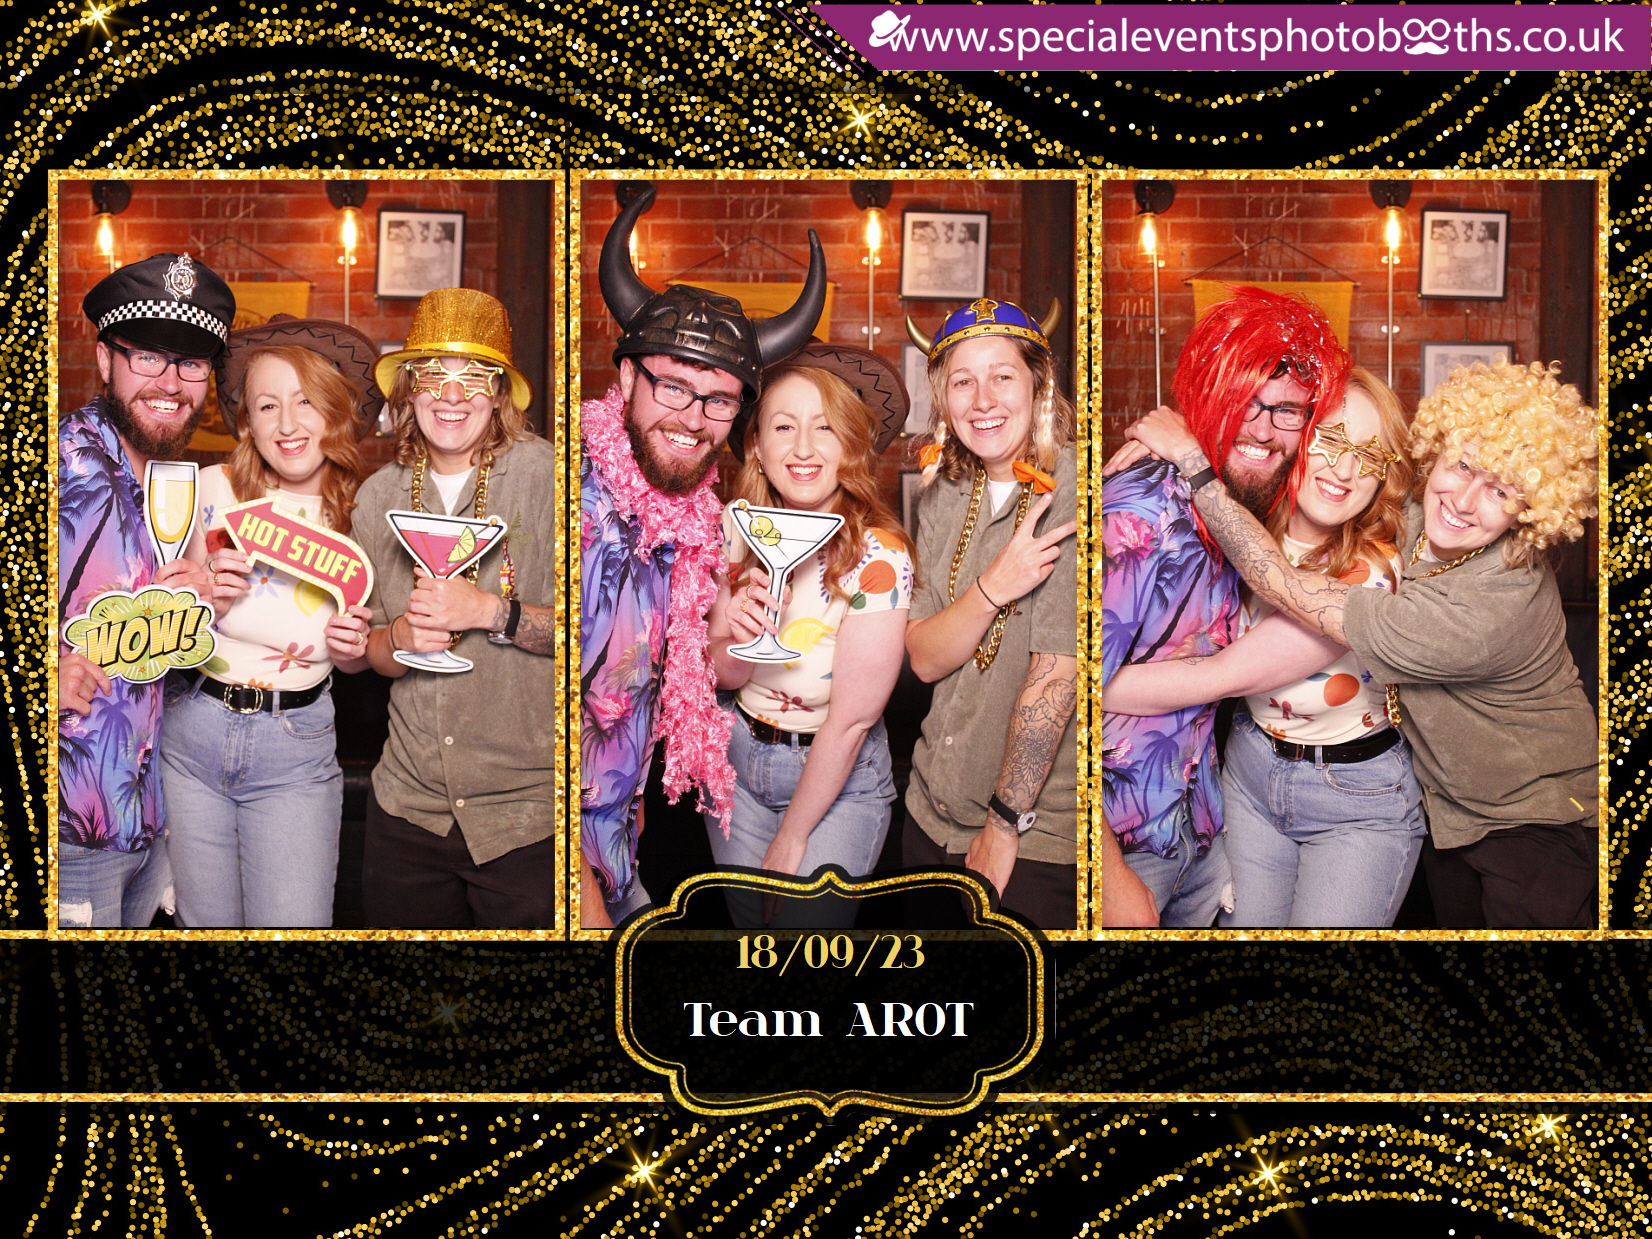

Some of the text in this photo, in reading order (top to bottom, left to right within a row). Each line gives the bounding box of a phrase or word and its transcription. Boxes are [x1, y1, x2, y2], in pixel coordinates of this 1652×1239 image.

[236, 512, 363, 584] HOT STUFF
[86, 606, 206, 668] WOW!
